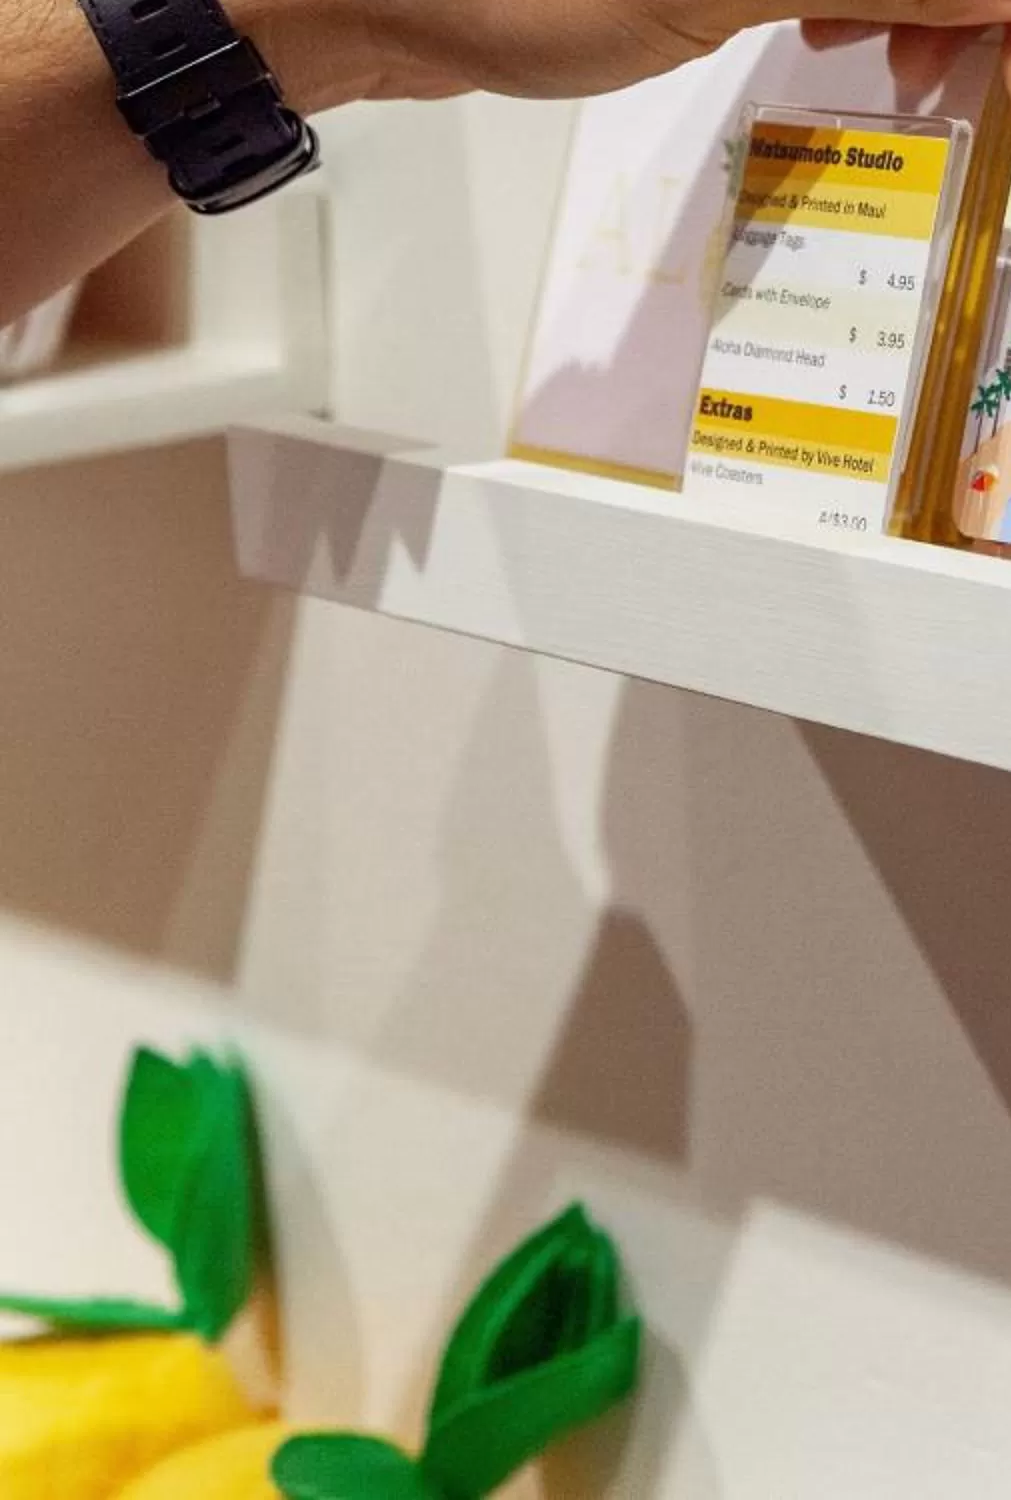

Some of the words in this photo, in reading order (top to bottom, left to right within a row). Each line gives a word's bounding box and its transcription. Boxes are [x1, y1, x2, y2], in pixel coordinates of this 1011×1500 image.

[844, 146, 904, 173] Studio
[800, 195, 841, 214] Printed
[857, 200, 887, 219] Maui
[859, 268, 868, 286] $
[887, 272, 915, 291] 4.95
[849, 327, 858, 344] $
[877, 331, 905, 350] 3.95
[743, 340, 794, 364] Diamond
[796, 347, 826, 368] Head
[699, 394, 754, 422] Extras
[839, 384, 848, 401] $
[866, 388, 896, 408] 1.50
[692, 429, 744, 453] Designed
[745, 439, 756, 454] &
[757, 440, 799, 461] Printed
[801, 446, 816, 467] by
[817, 450, 841, 469] Vive
[842, 457, 875, 474] Hotel
